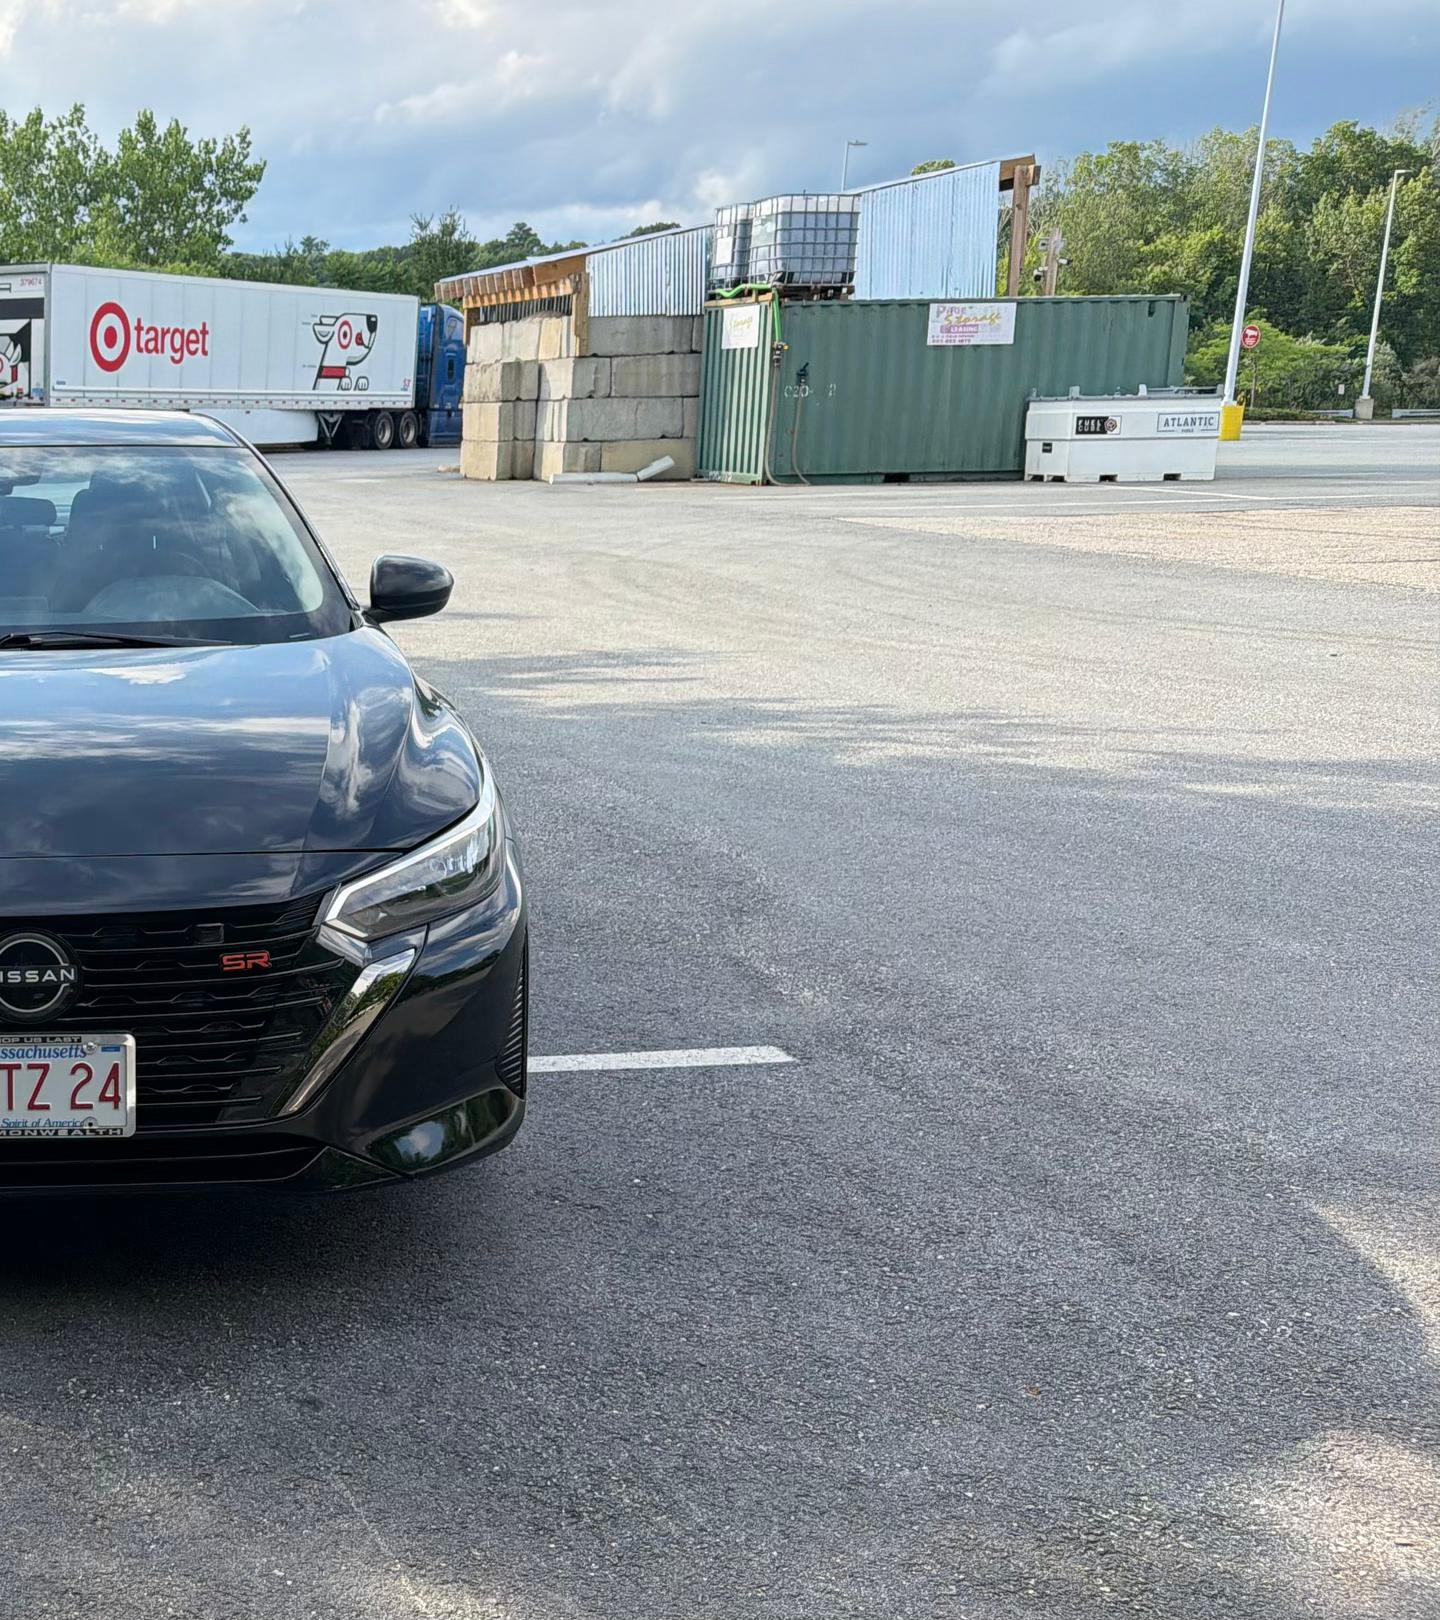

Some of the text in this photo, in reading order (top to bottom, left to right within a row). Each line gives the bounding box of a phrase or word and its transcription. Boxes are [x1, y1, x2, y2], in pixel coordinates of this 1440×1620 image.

[134, 317, 209, 365] target
[1163, 416, 1214, 428] ATLANTIC
[222, 951, 272, 971] SR
[70, 1061, 122, 1110] 24
[1, 1118, 28, 1128] Spirit
[31, 1118, 41, 1128] of
[43, 1118, 83, 1128] Americ
